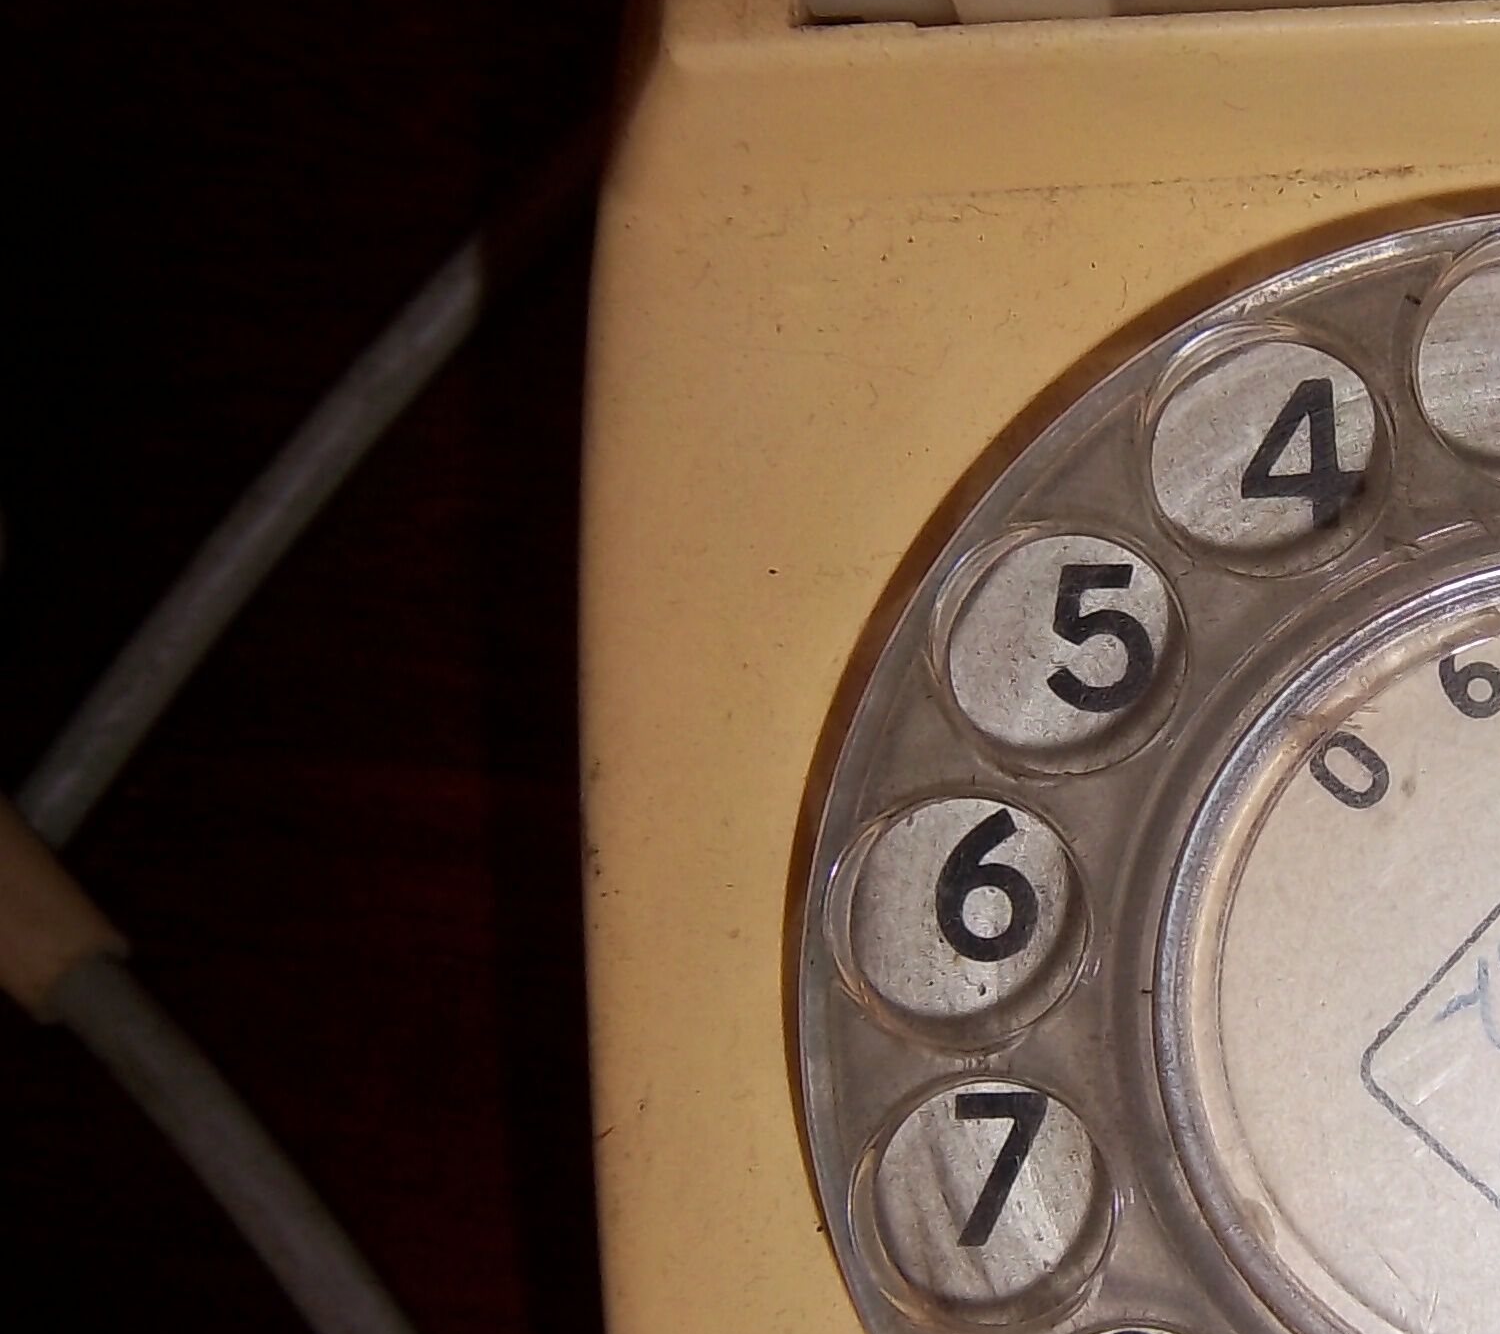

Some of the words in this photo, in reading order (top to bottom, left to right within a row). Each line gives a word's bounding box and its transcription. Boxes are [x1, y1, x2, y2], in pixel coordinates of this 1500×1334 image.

[1241, 378, 1365, 528] 4
[1047, 564, 1154, 713] 5
[1310, 731, 1389, 809] 0
[936, 808, 1038, 962] 6
[956, 1092, 1048, 1246] 7
